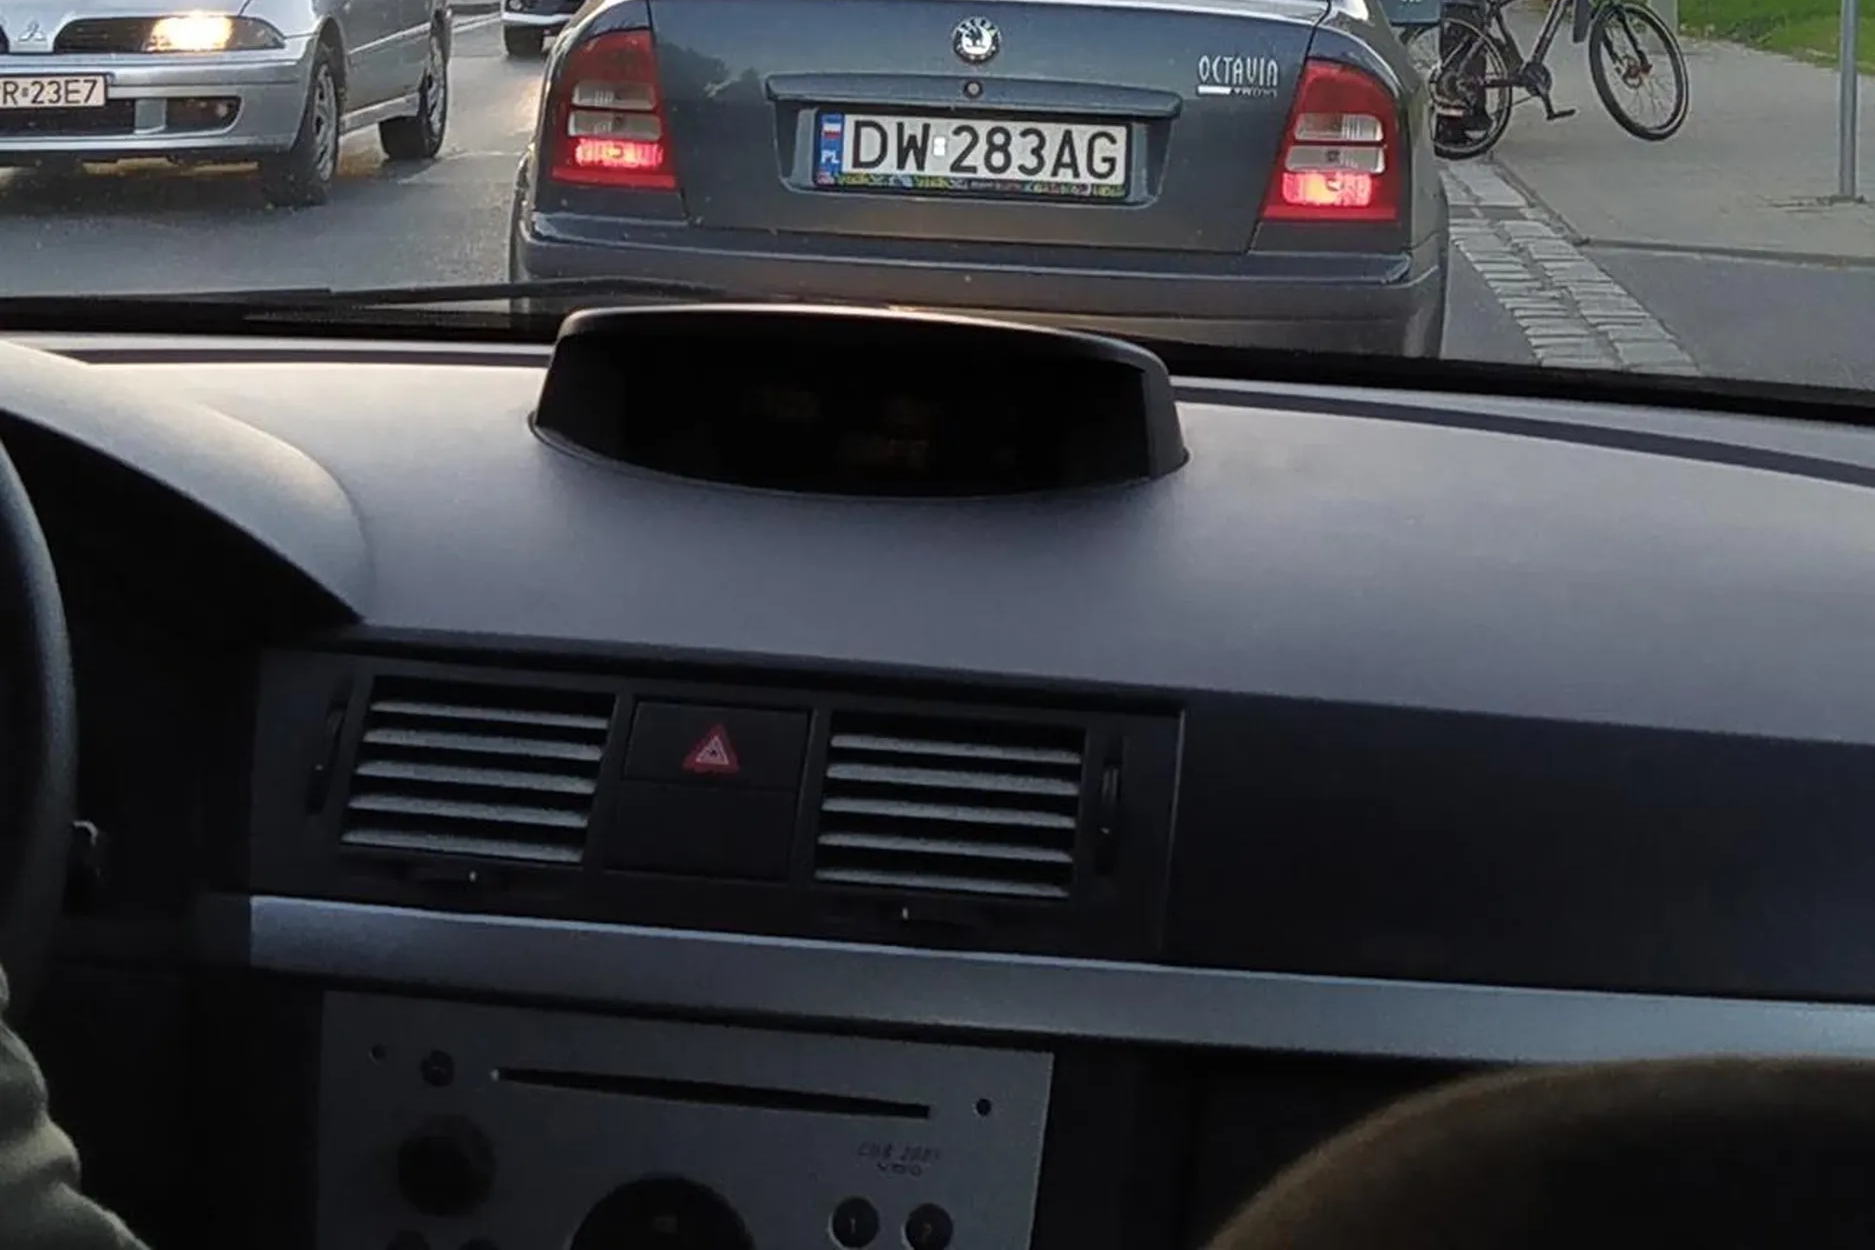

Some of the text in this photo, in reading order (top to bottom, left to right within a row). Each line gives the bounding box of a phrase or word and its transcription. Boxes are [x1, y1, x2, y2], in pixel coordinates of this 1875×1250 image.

[1199, 55, 1278, 86] OCTAVIA
[30, 79, 98, 104] 23E7
[820, 149, 840, 164] PL
[852, 119, 1119, 180] DW 283AG
